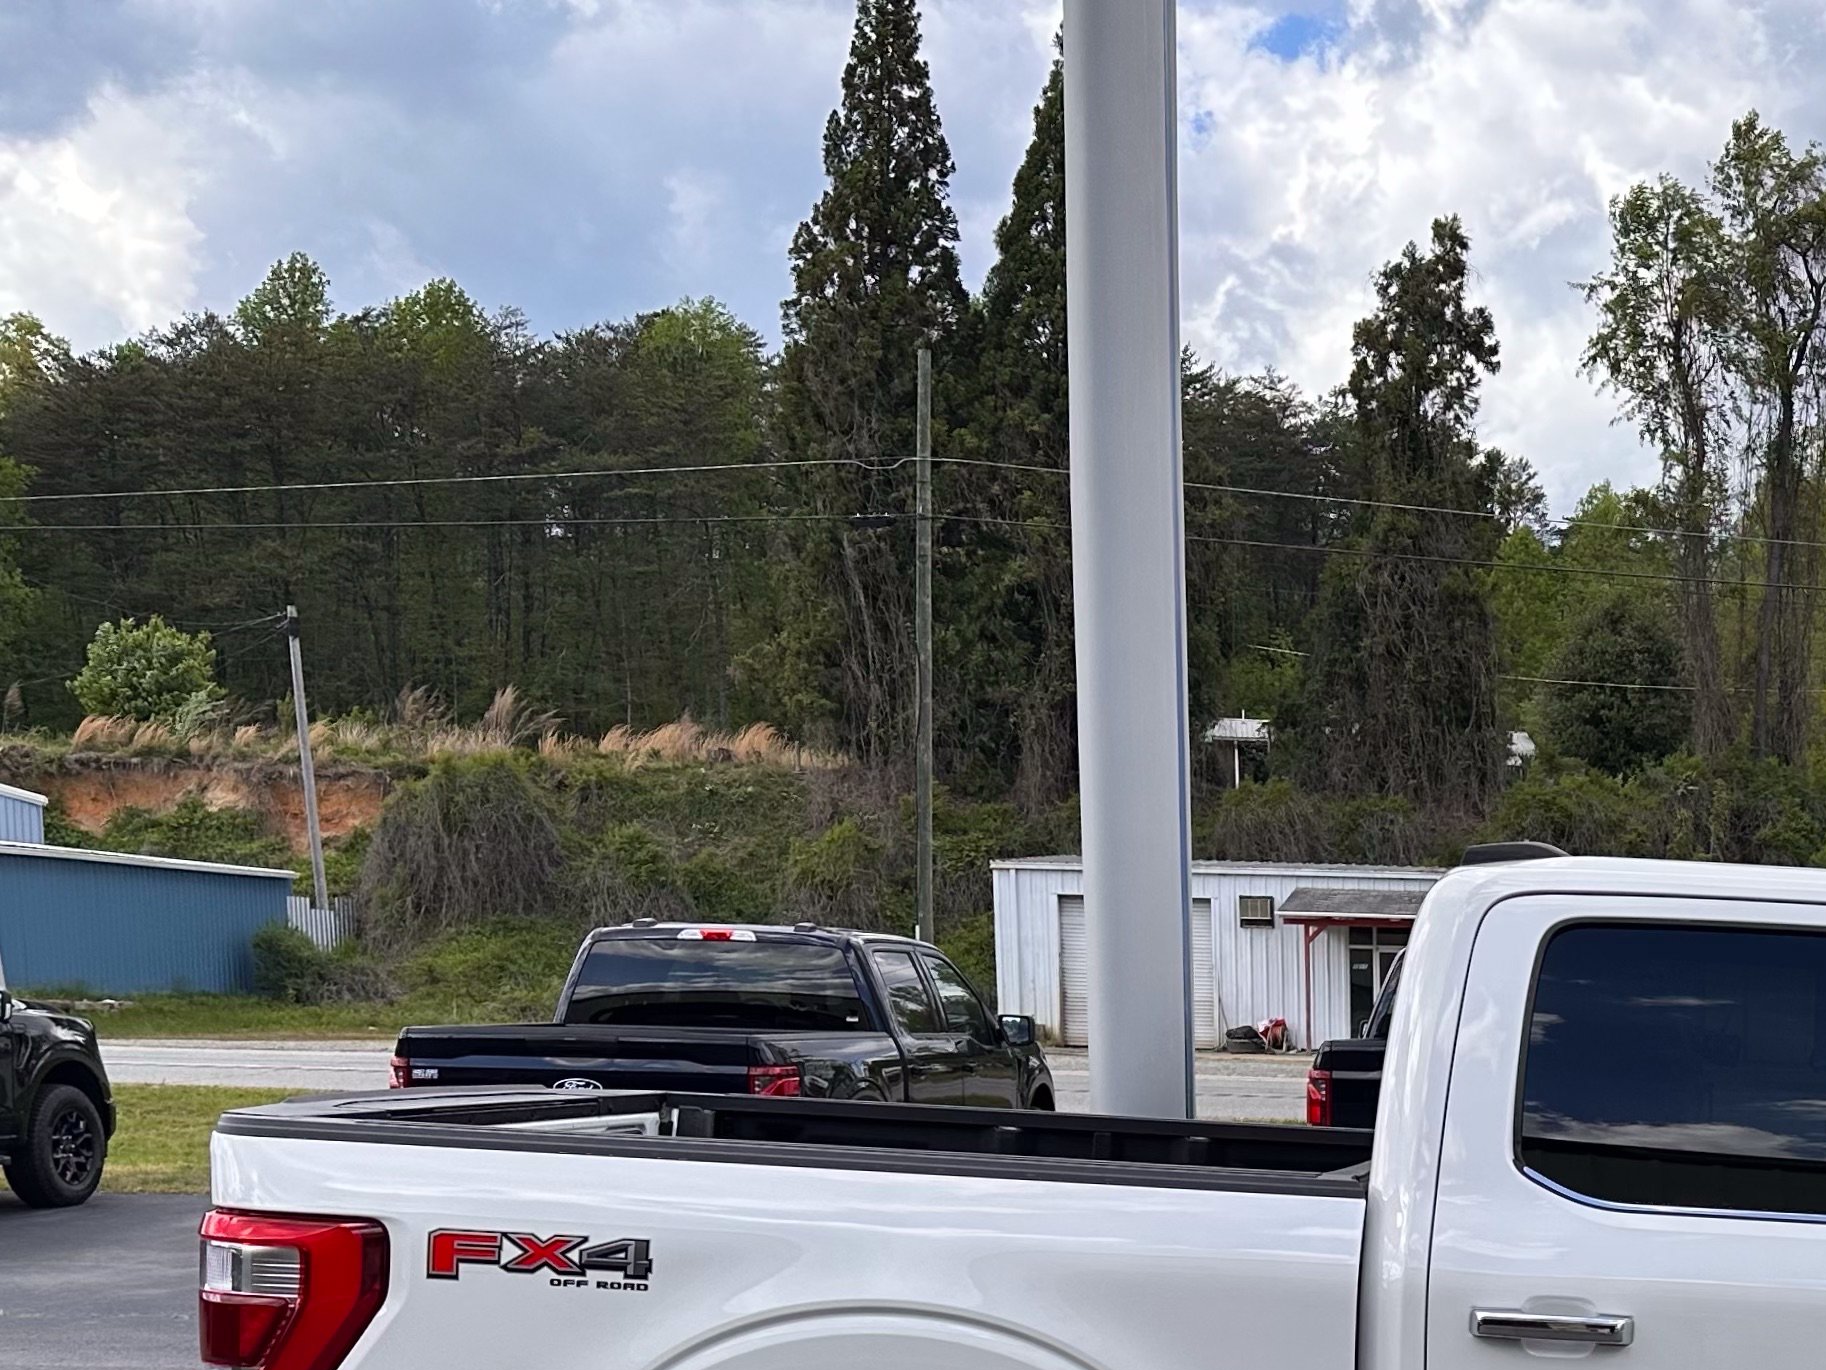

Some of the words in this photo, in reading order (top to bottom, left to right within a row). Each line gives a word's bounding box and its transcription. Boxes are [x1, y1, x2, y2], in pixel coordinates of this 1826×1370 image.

[426, 1228, 653, 1281] FX4
[549, 1278, 589, 1288] OFF
[596, 1280, 649, 1292] ROAD
